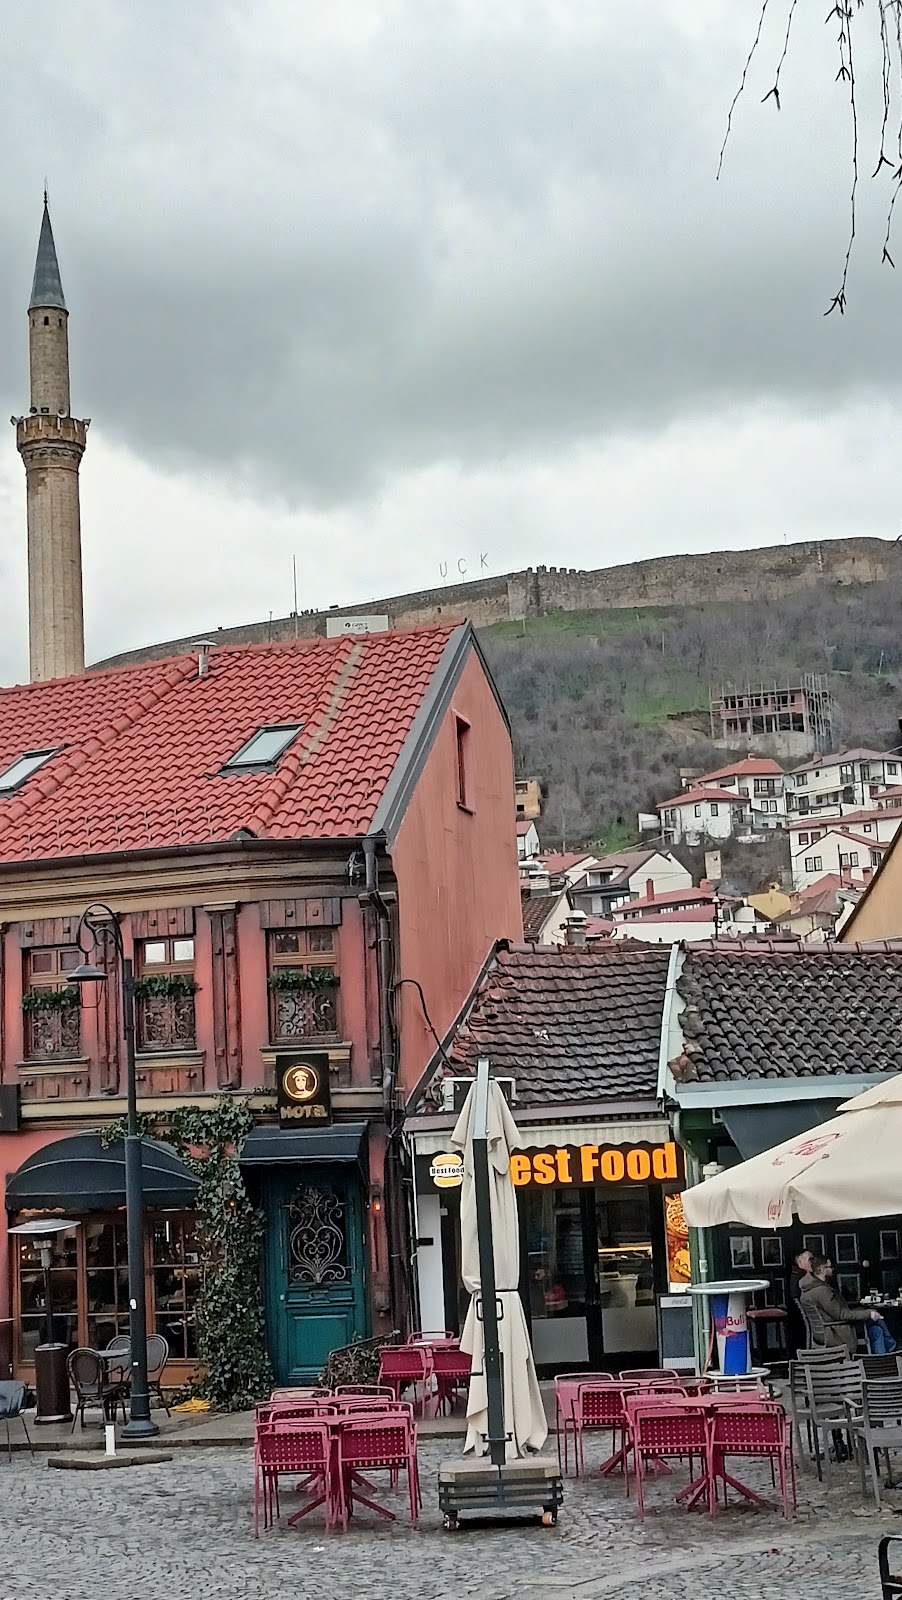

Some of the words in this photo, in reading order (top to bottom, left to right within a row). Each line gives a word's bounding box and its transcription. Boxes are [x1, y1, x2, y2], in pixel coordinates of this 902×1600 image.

[280, 1104, 328, 1119] HOTEL
[510, 1148, 573, 1186] est
[580, 1141, 678, 1183] Food
